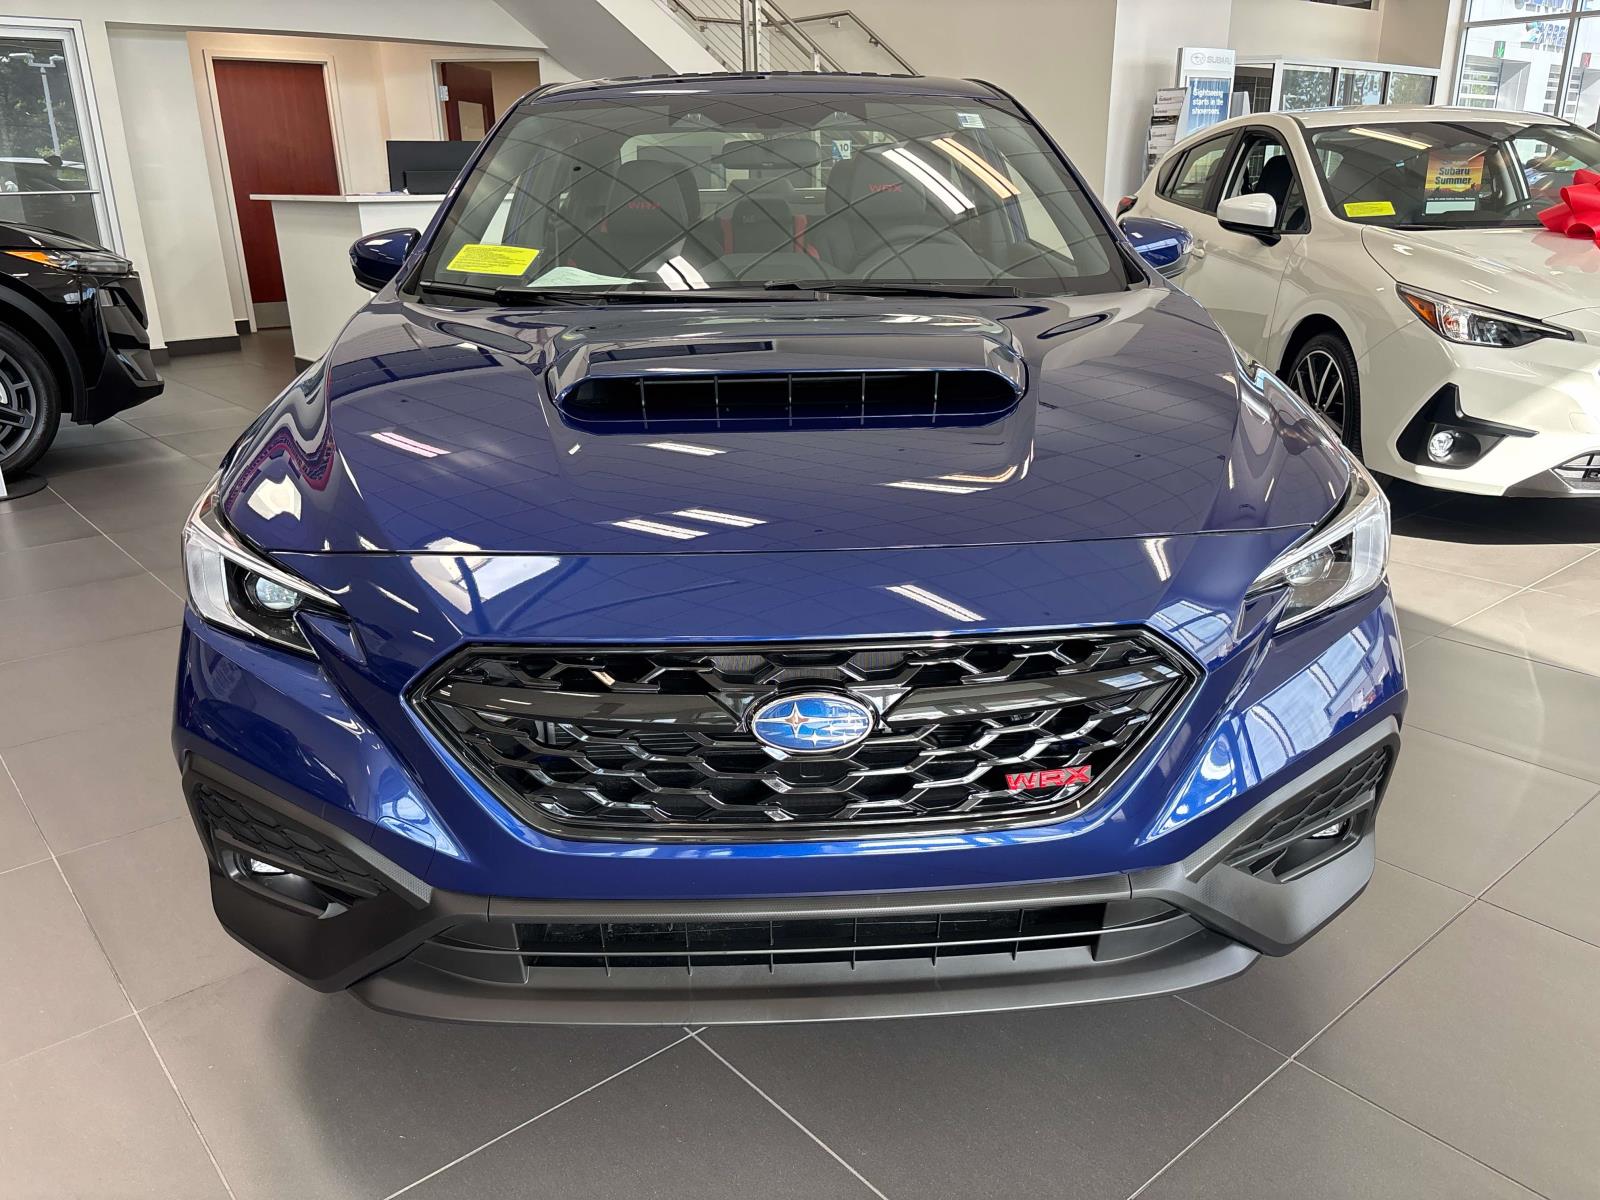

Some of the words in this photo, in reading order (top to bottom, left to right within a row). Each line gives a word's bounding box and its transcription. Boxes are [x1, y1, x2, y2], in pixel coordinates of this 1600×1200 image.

[1192, 98, 1209, 106] starts
[1210, 98, 1215, 106] in
[839, 143, 849, 152] 10
[1439, 167, 1470, 176] Subaru
[1435, 176, 1472, 185] Summer
[868, 183, 902, 192] WRX
[1006, 765, 1091, 790] WRX
